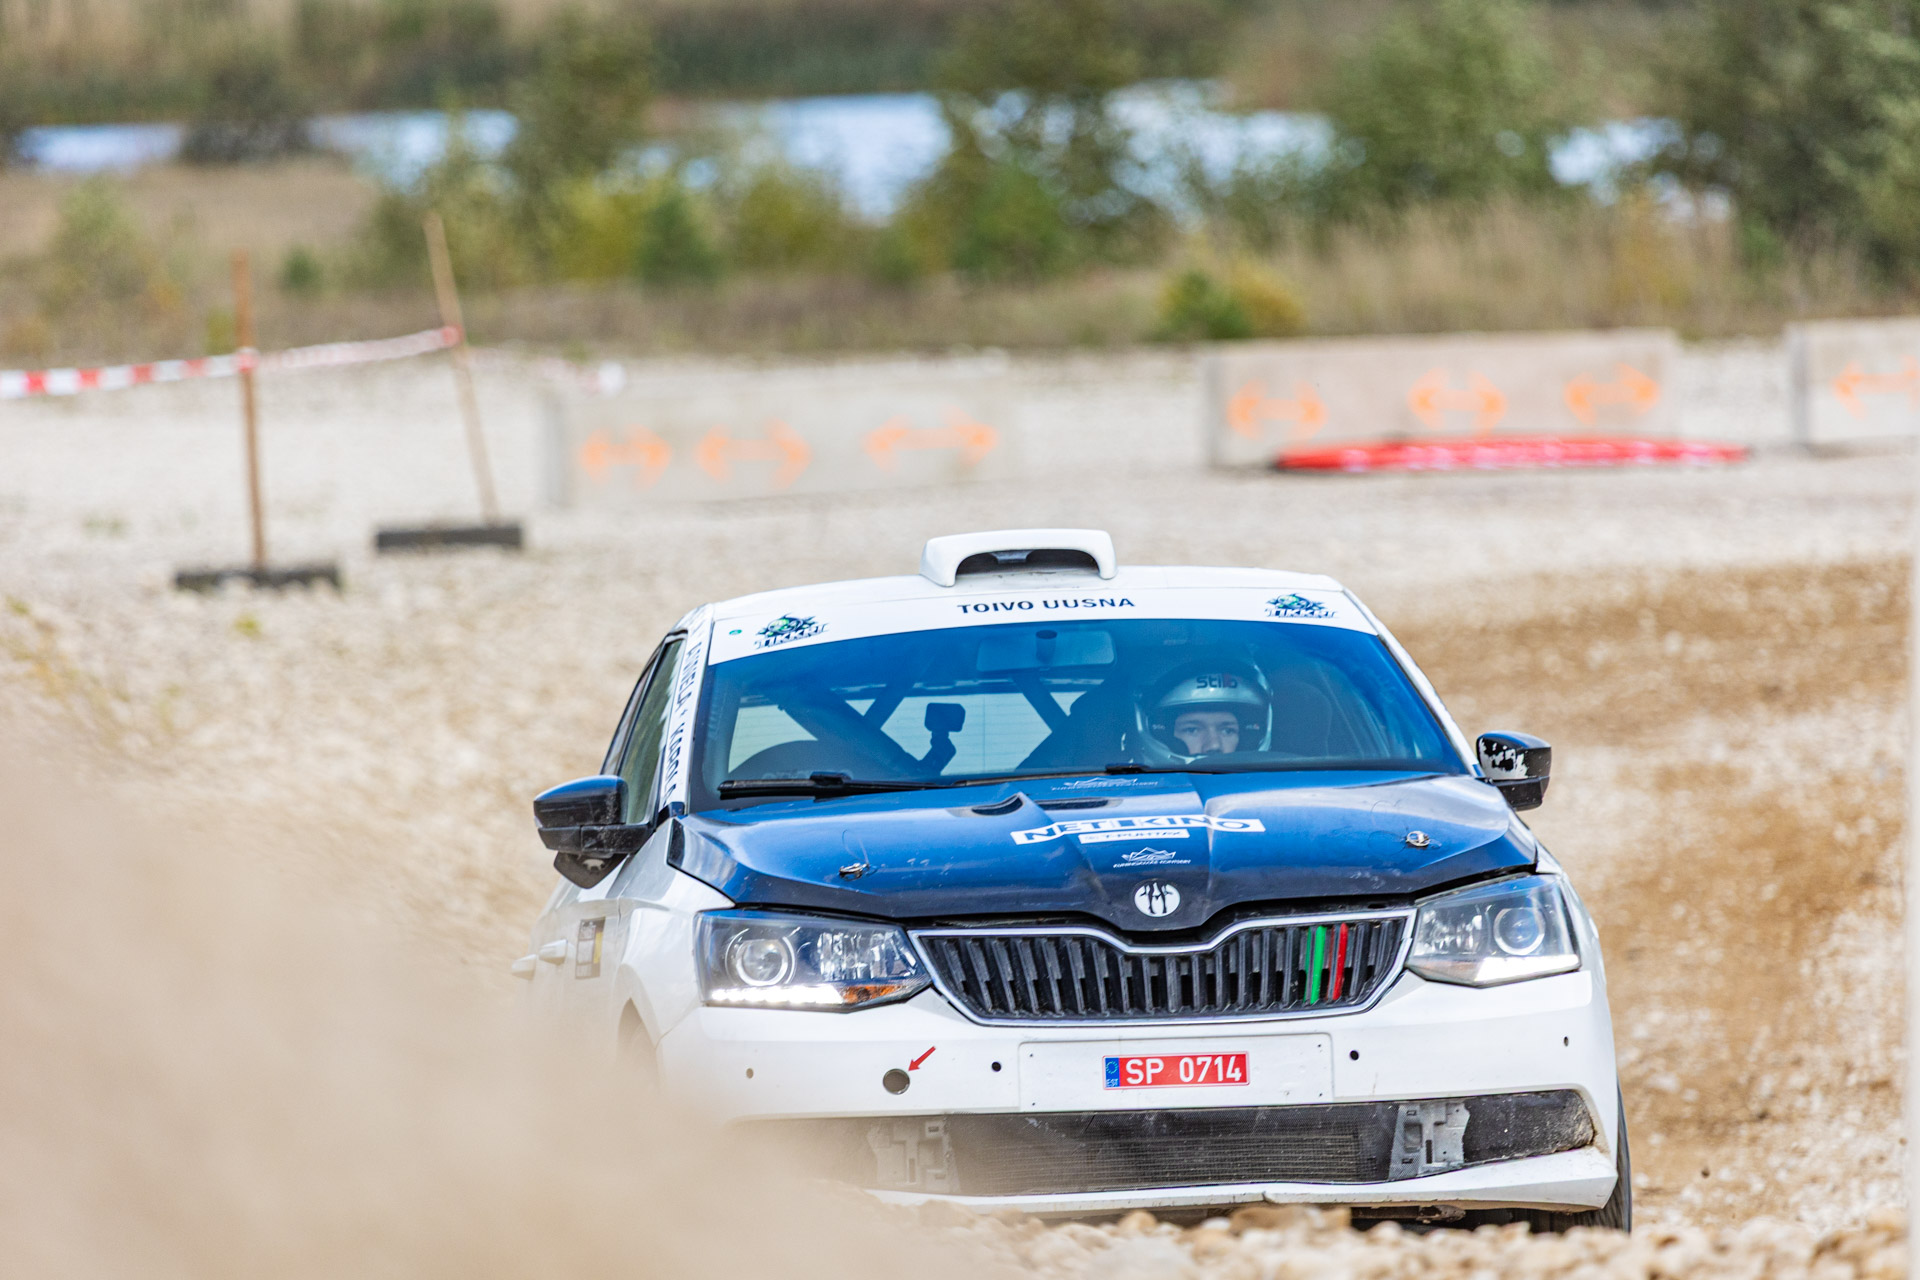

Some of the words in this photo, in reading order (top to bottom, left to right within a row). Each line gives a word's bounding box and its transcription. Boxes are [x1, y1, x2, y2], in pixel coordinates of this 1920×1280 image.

[957, 600, 1034, 614] TOIVO
[1043, 598, 1135, 609] UUSNA
[1125, 1058, 1164, 1085] SP
[1179, 1055, 1242, 1083] 0714
